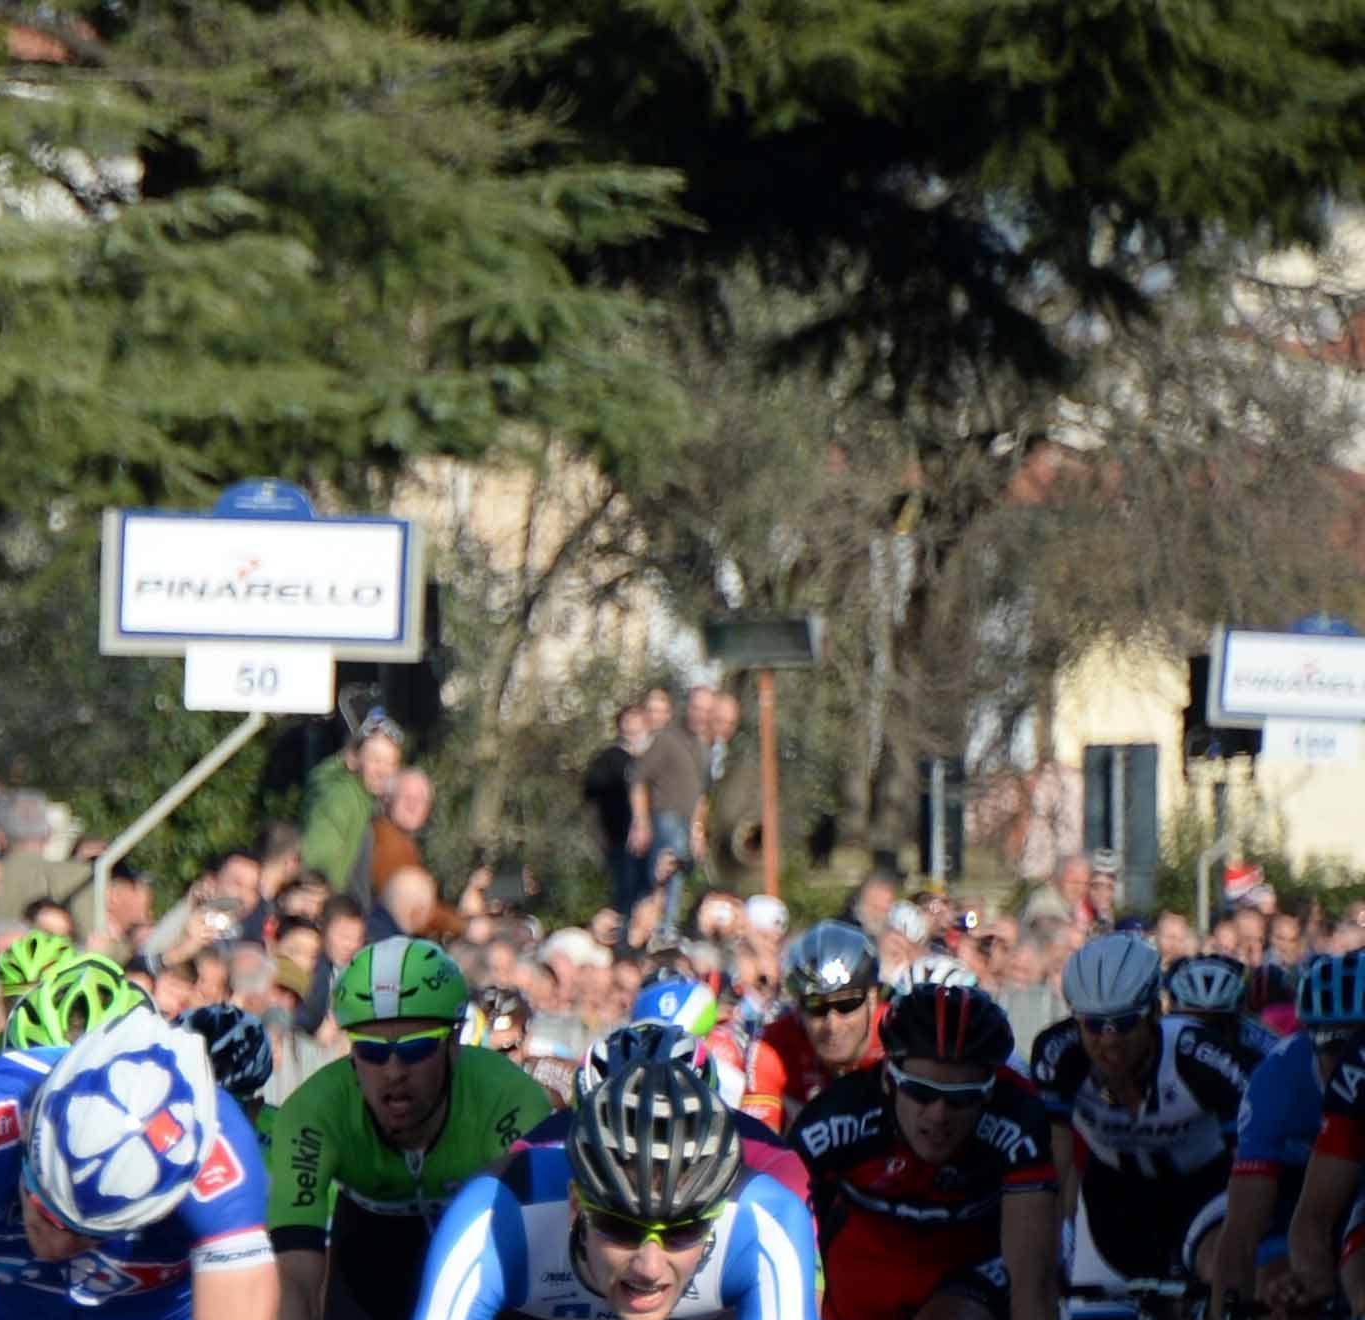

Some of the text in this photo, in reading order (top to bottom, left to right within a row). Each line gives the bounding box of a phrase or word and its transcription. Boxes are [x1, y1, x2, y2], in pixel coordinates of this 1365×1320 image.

[135, 574, 383, 608] PINARELLO
[235, 664, 279, 696] 50
[1330, 1050, 1365, 1104] IA
[801, 1107, 883, 1159] BMC
[976, 1112, 1038, 1164] BMC
[292, 1125, 323, 1207] belkin
